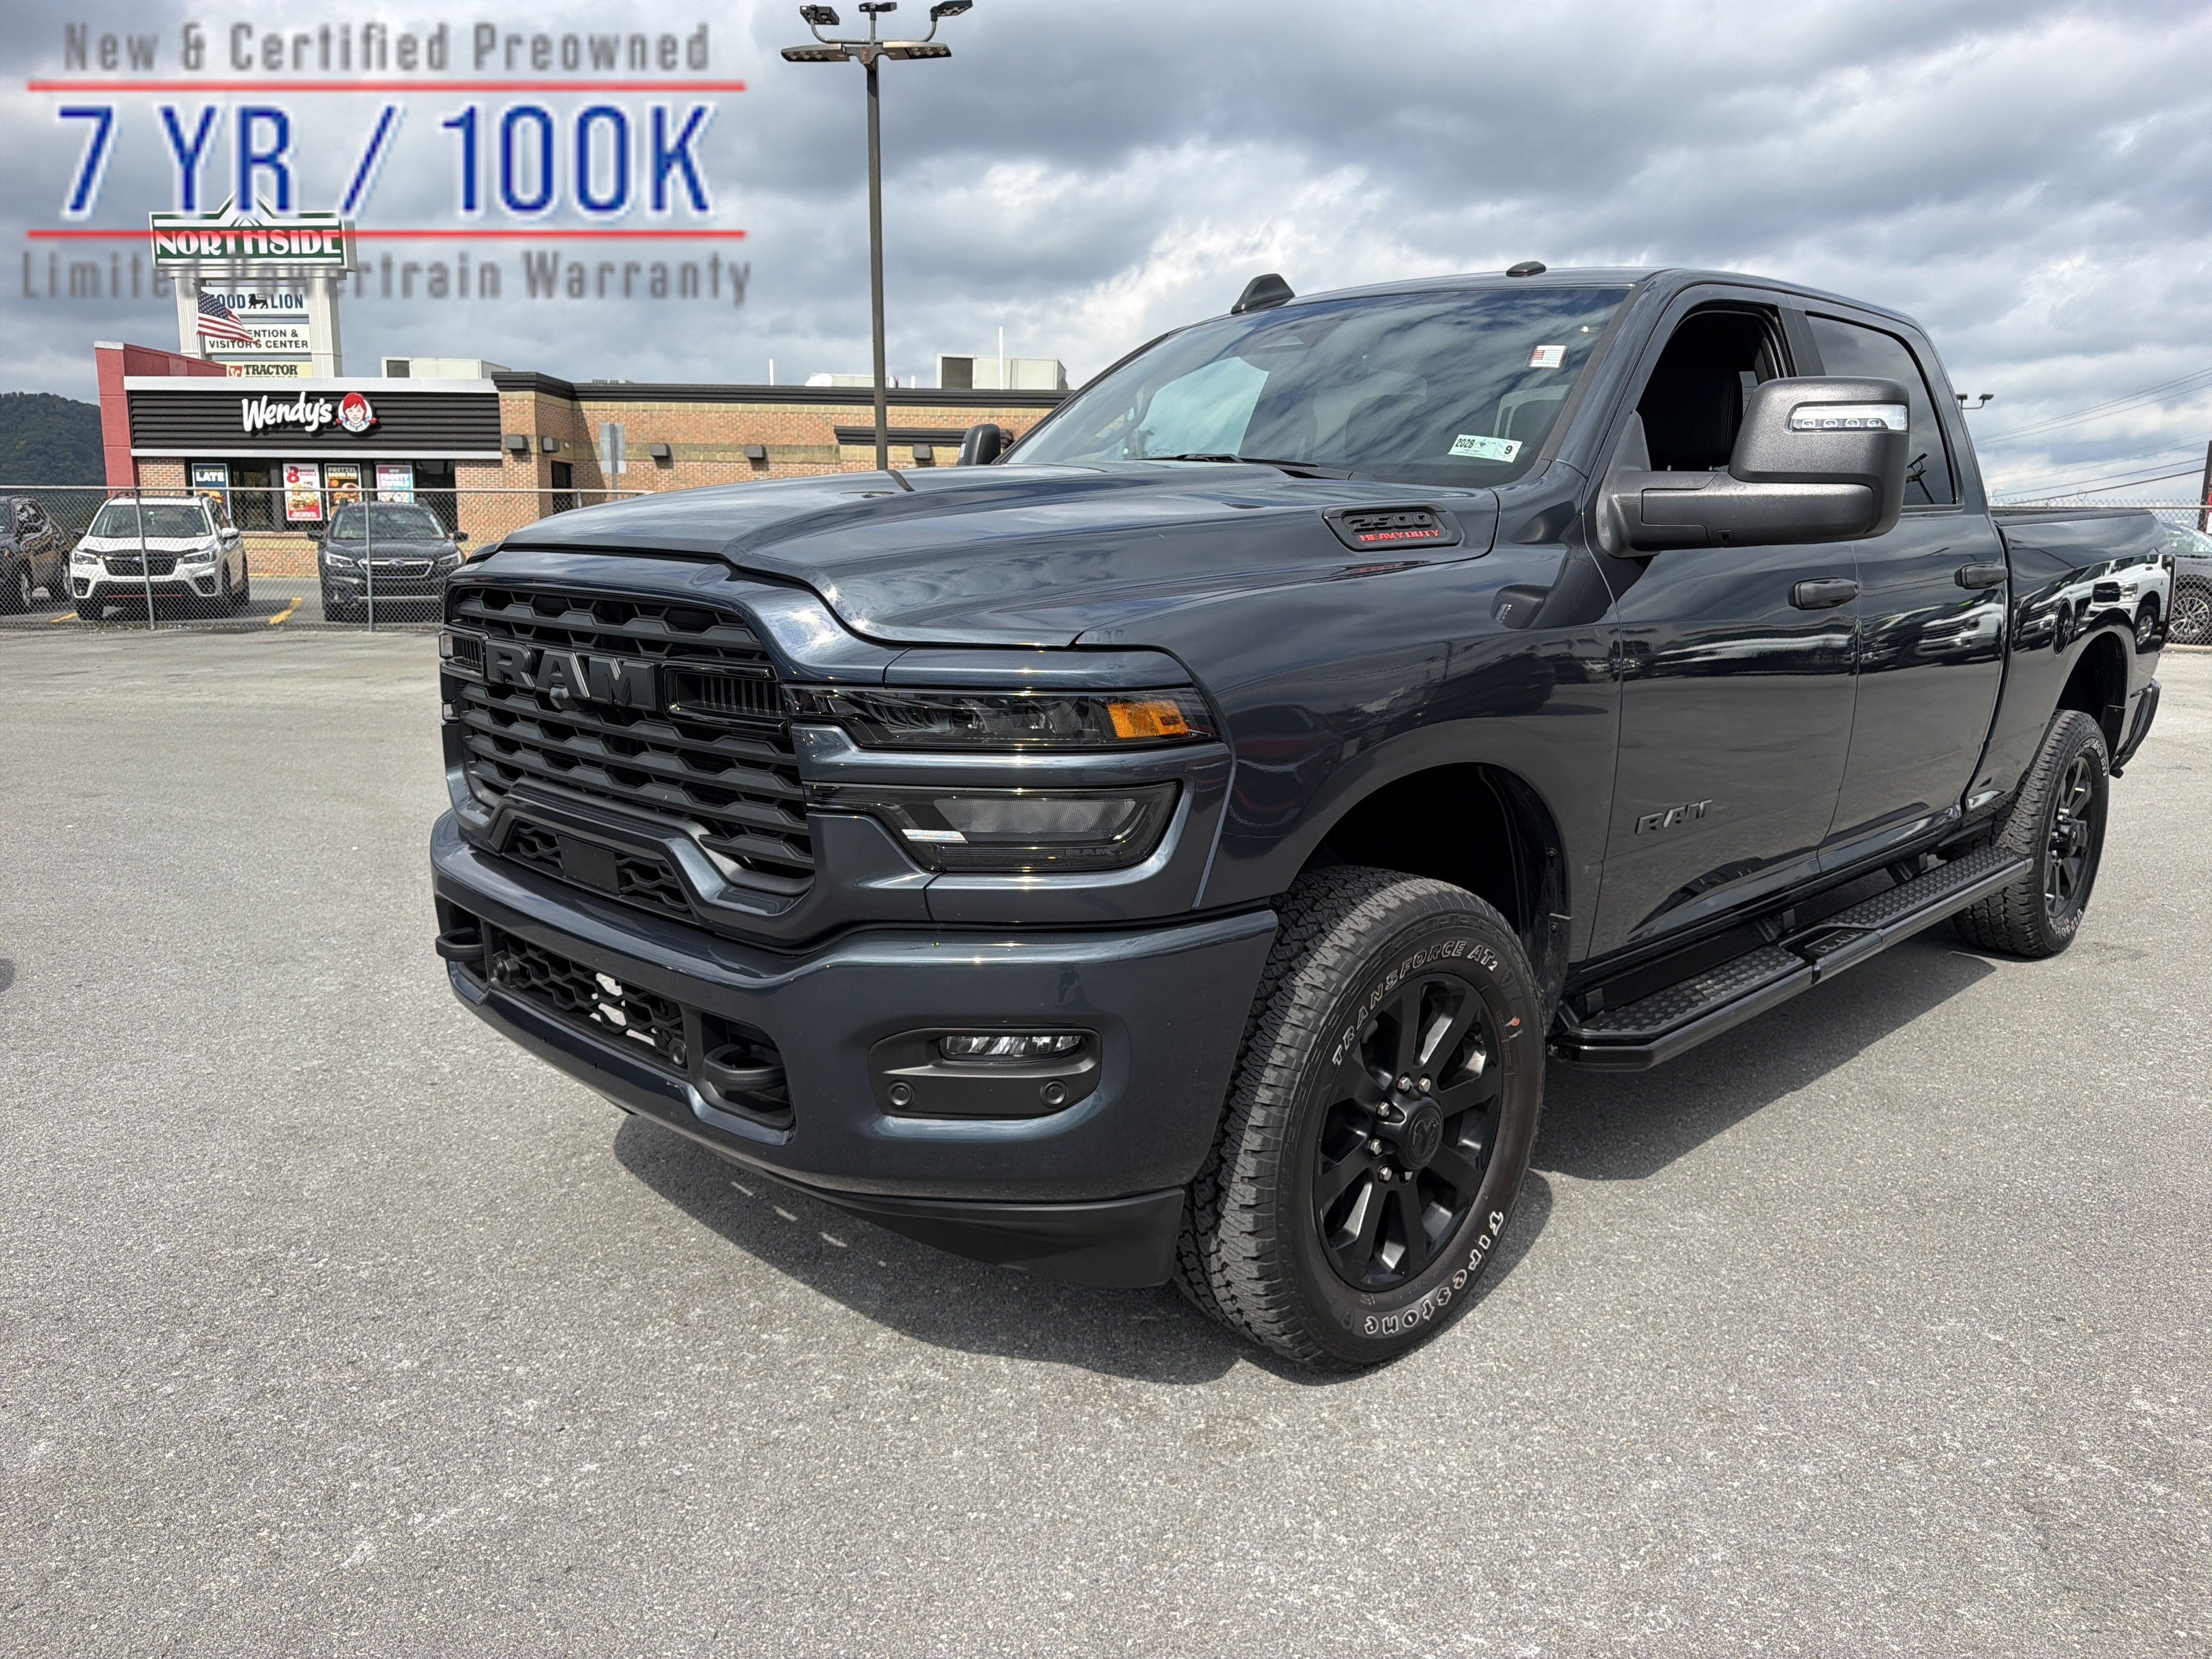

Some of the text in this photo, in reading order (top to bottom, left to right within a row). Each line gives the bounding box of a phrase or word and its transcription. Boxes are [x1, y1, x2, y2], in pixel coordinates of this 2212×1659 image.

[155, 229, 341, 256] NORTHSIDE
[212, 294, 303, 309] OOD LION
[291, 329, 298, 337] &
[265, 340, 308, 348] CENTER
[244, 364, 298, 375] TRACTOR
[241, 391, 332, 432] Wendy's
[1454, 438, 1476, 449] 2028
[1504, 445, 1513, 455] 9
[195, 471, 224, 482] LATE
[1348, 514, 1433, 532] 2500
[1359, 529, 1439, 542] HEAVY DUTY
[486, 640, 660, 712] RAM
[1331, 940, 1467, 1066] TRANSFORCE
[1363, 1210, 1505, 1335] Firestone
